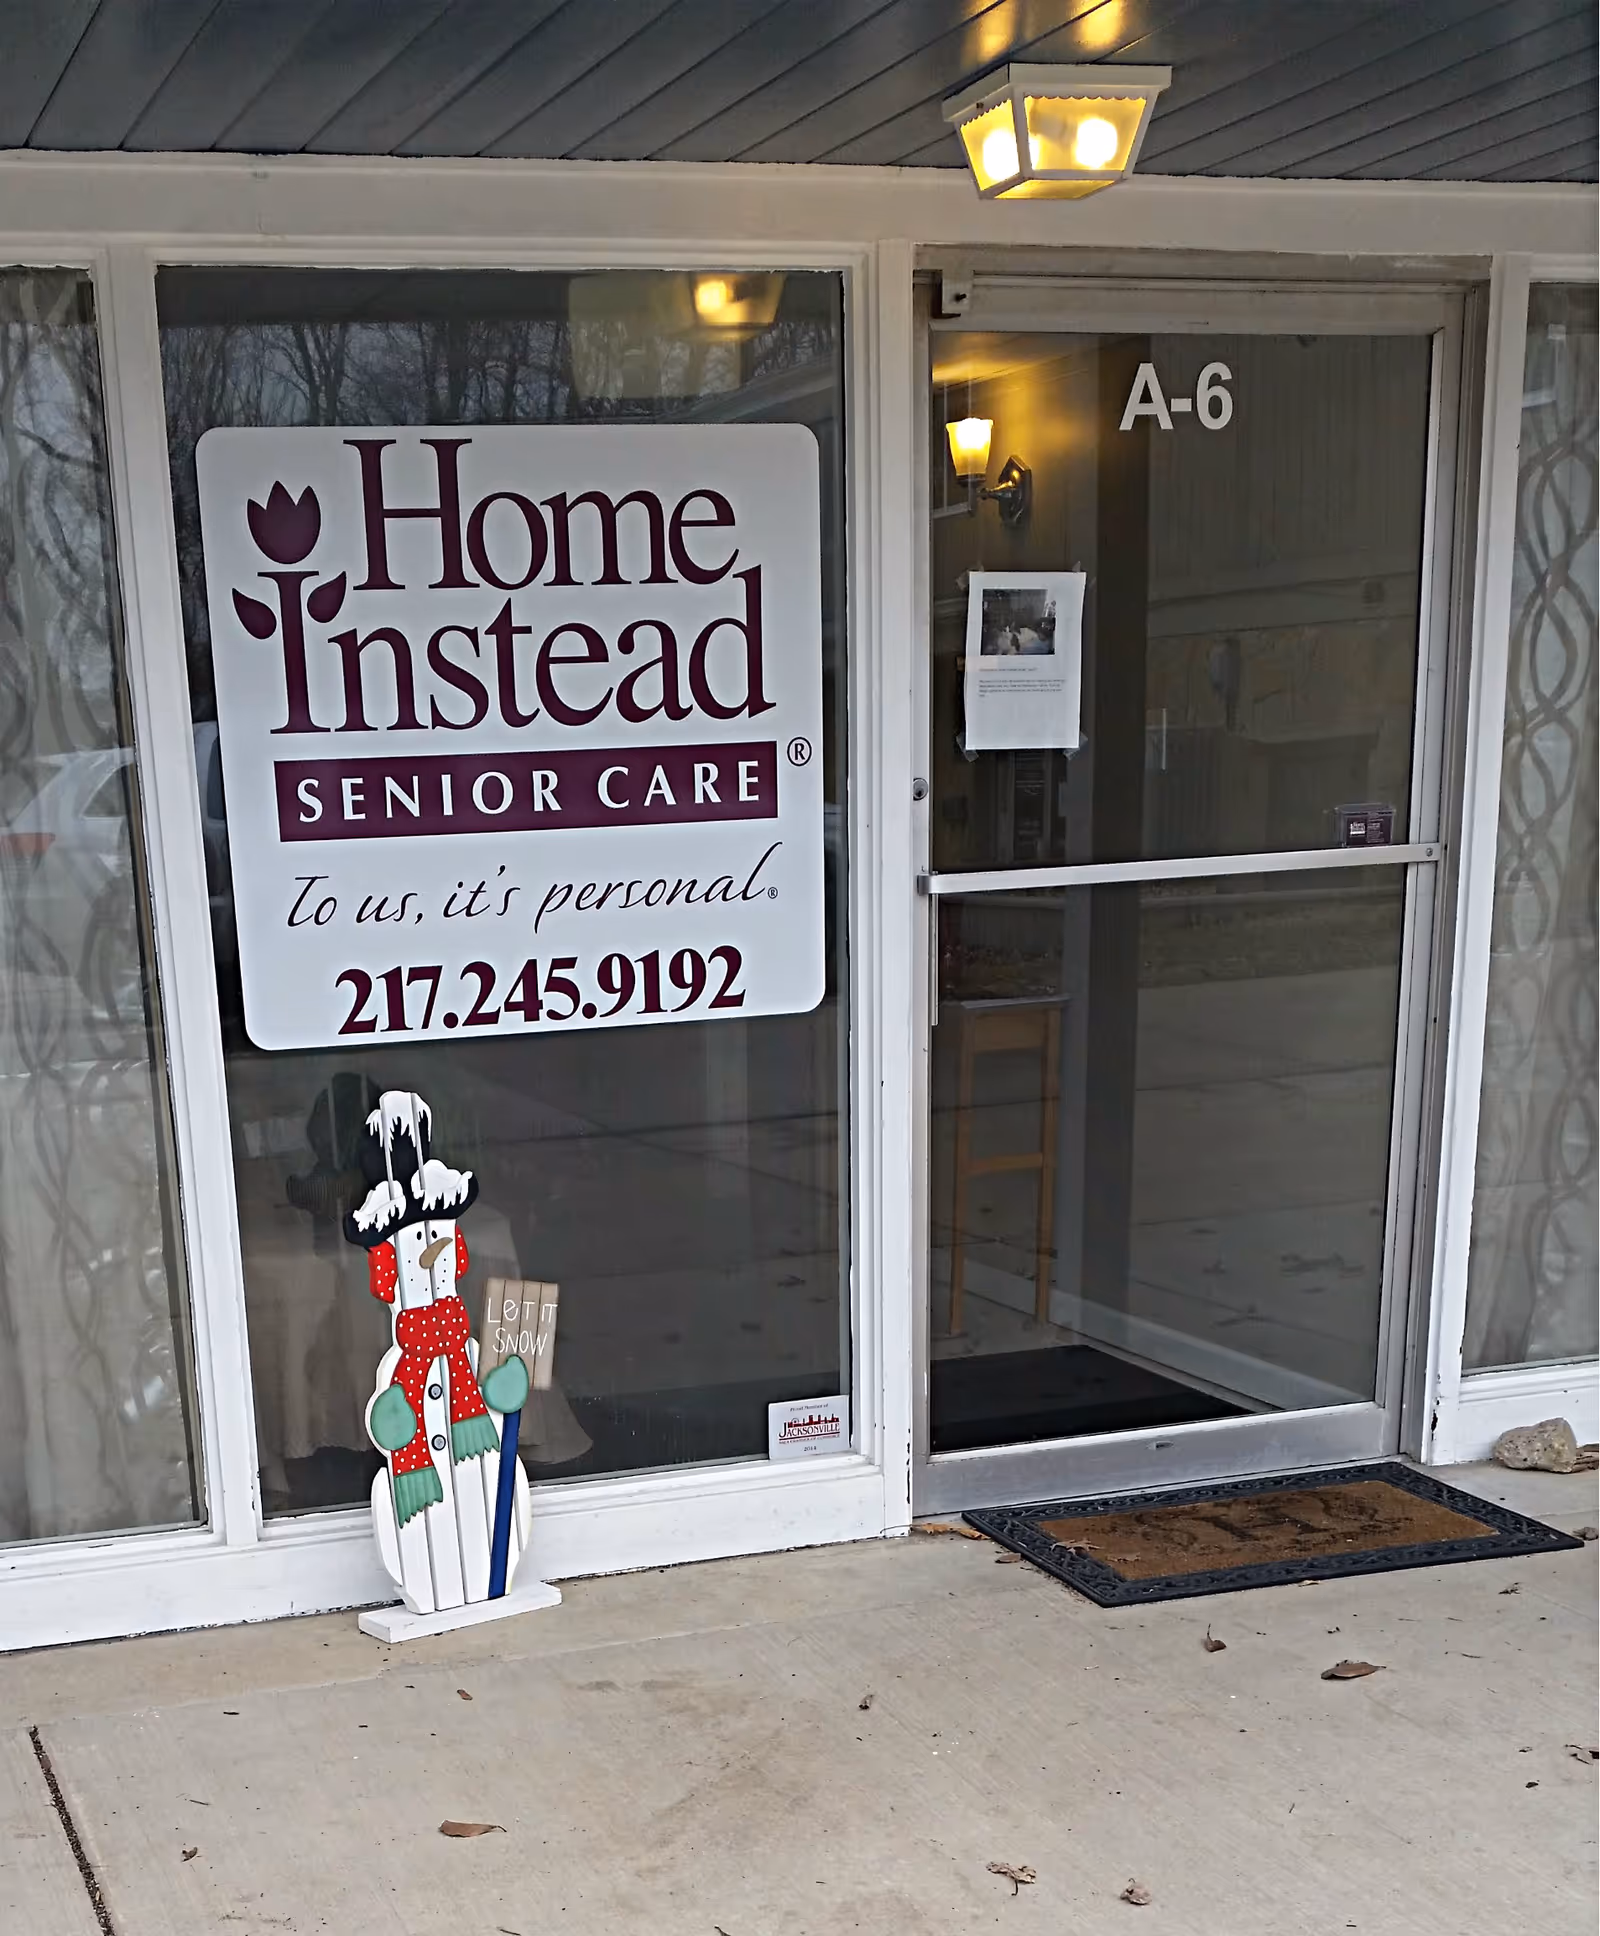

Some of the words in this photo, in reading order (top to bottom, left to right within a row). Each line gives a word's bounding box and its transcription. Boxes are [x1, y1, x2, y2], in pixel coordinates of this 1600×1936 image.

[1119, 361, 1233, 431] A-6
[343, 438, 740, 590] Home
[270, 564, 777, 734] Instead
[298, 769, 563, 824] SENIOR
[597, 760, 761, 809] CARE
[287, 876, 337, 928] To
[356, 890, 424, 924] us,
[443, 866, 520, 918] it's
[335, 945, 747, 1036] 217.245.9192
[492, 1327, 548, 1356] SNOW
[541, 1303, 558, 1323] IT
[779, 1421, 840, 1437] JACKSONVILLE
